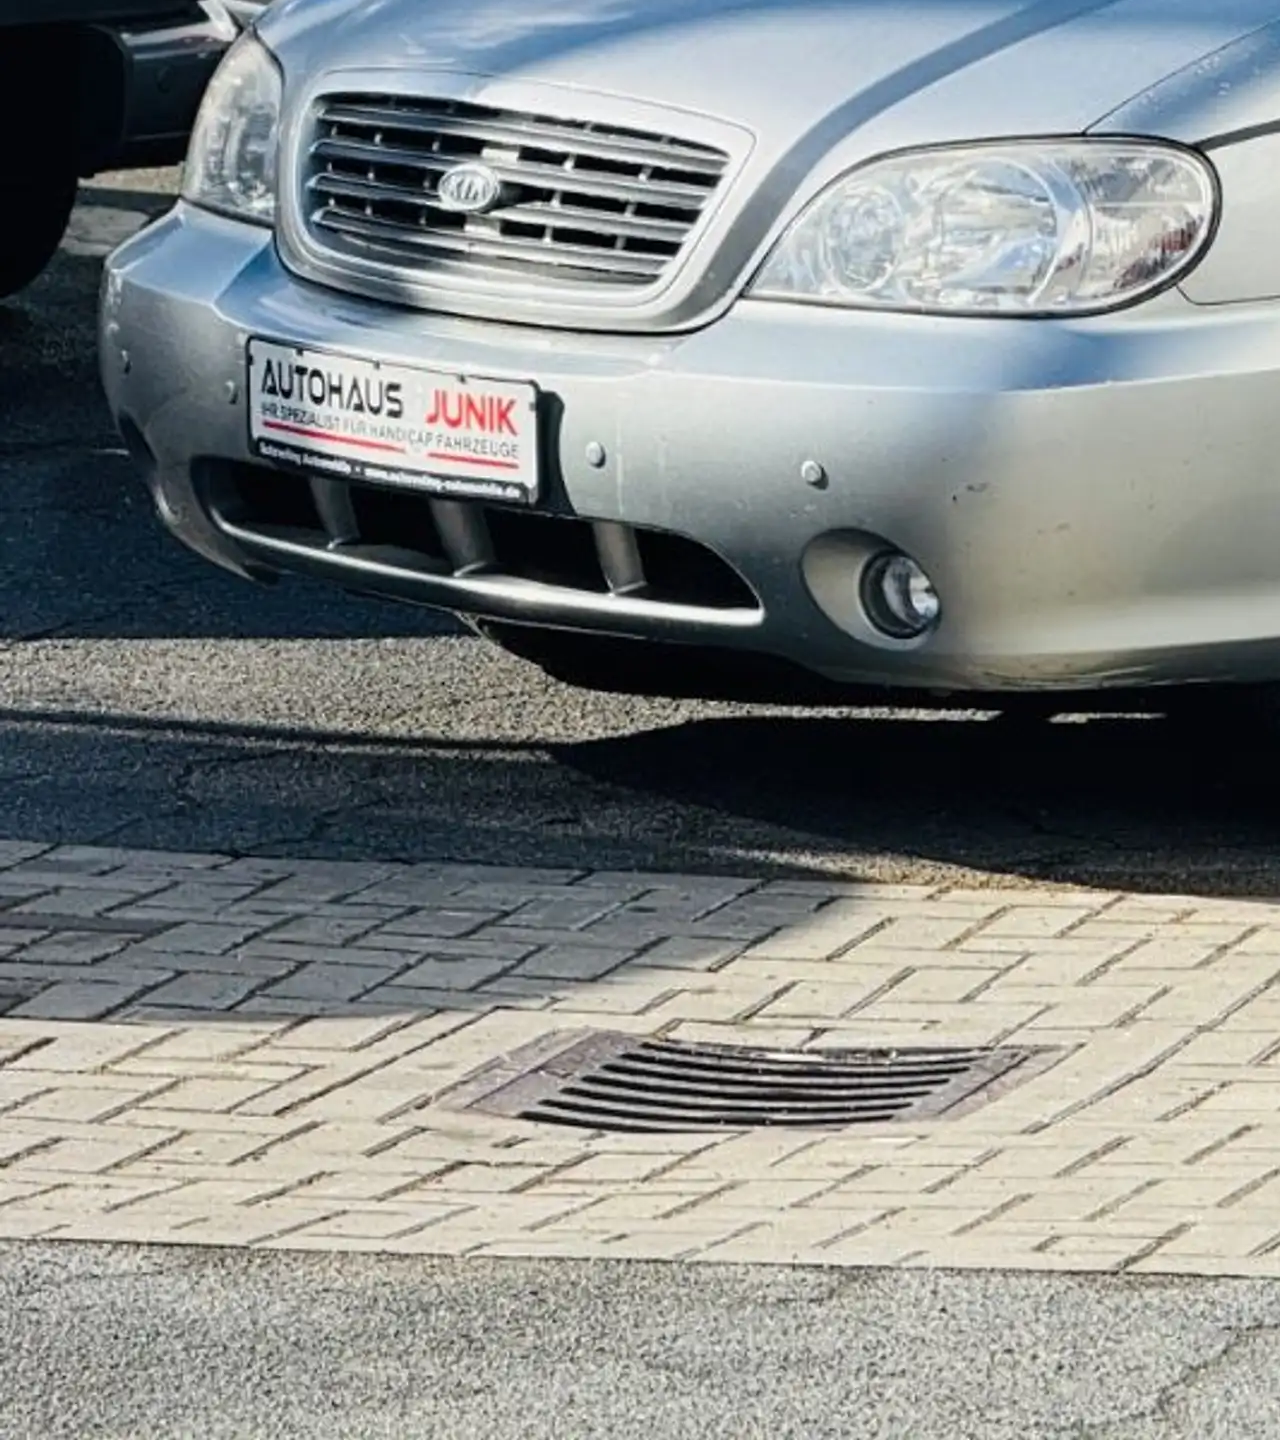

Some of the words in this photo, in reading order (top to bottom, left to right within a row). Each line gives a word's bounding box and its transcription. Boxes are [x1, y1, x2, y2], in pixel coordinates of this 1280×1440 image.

[261, 357, 404, 419] AUTOHAUS
[425, 388, 518, 435] JUNIK
[261, 401, 277, 419] IHR
[279, 404, 341, 431] SPEZIALIST
[369, 422, 433, 446] HANDICAP
[435, 434, 519, 459] FAHRZEUGE
